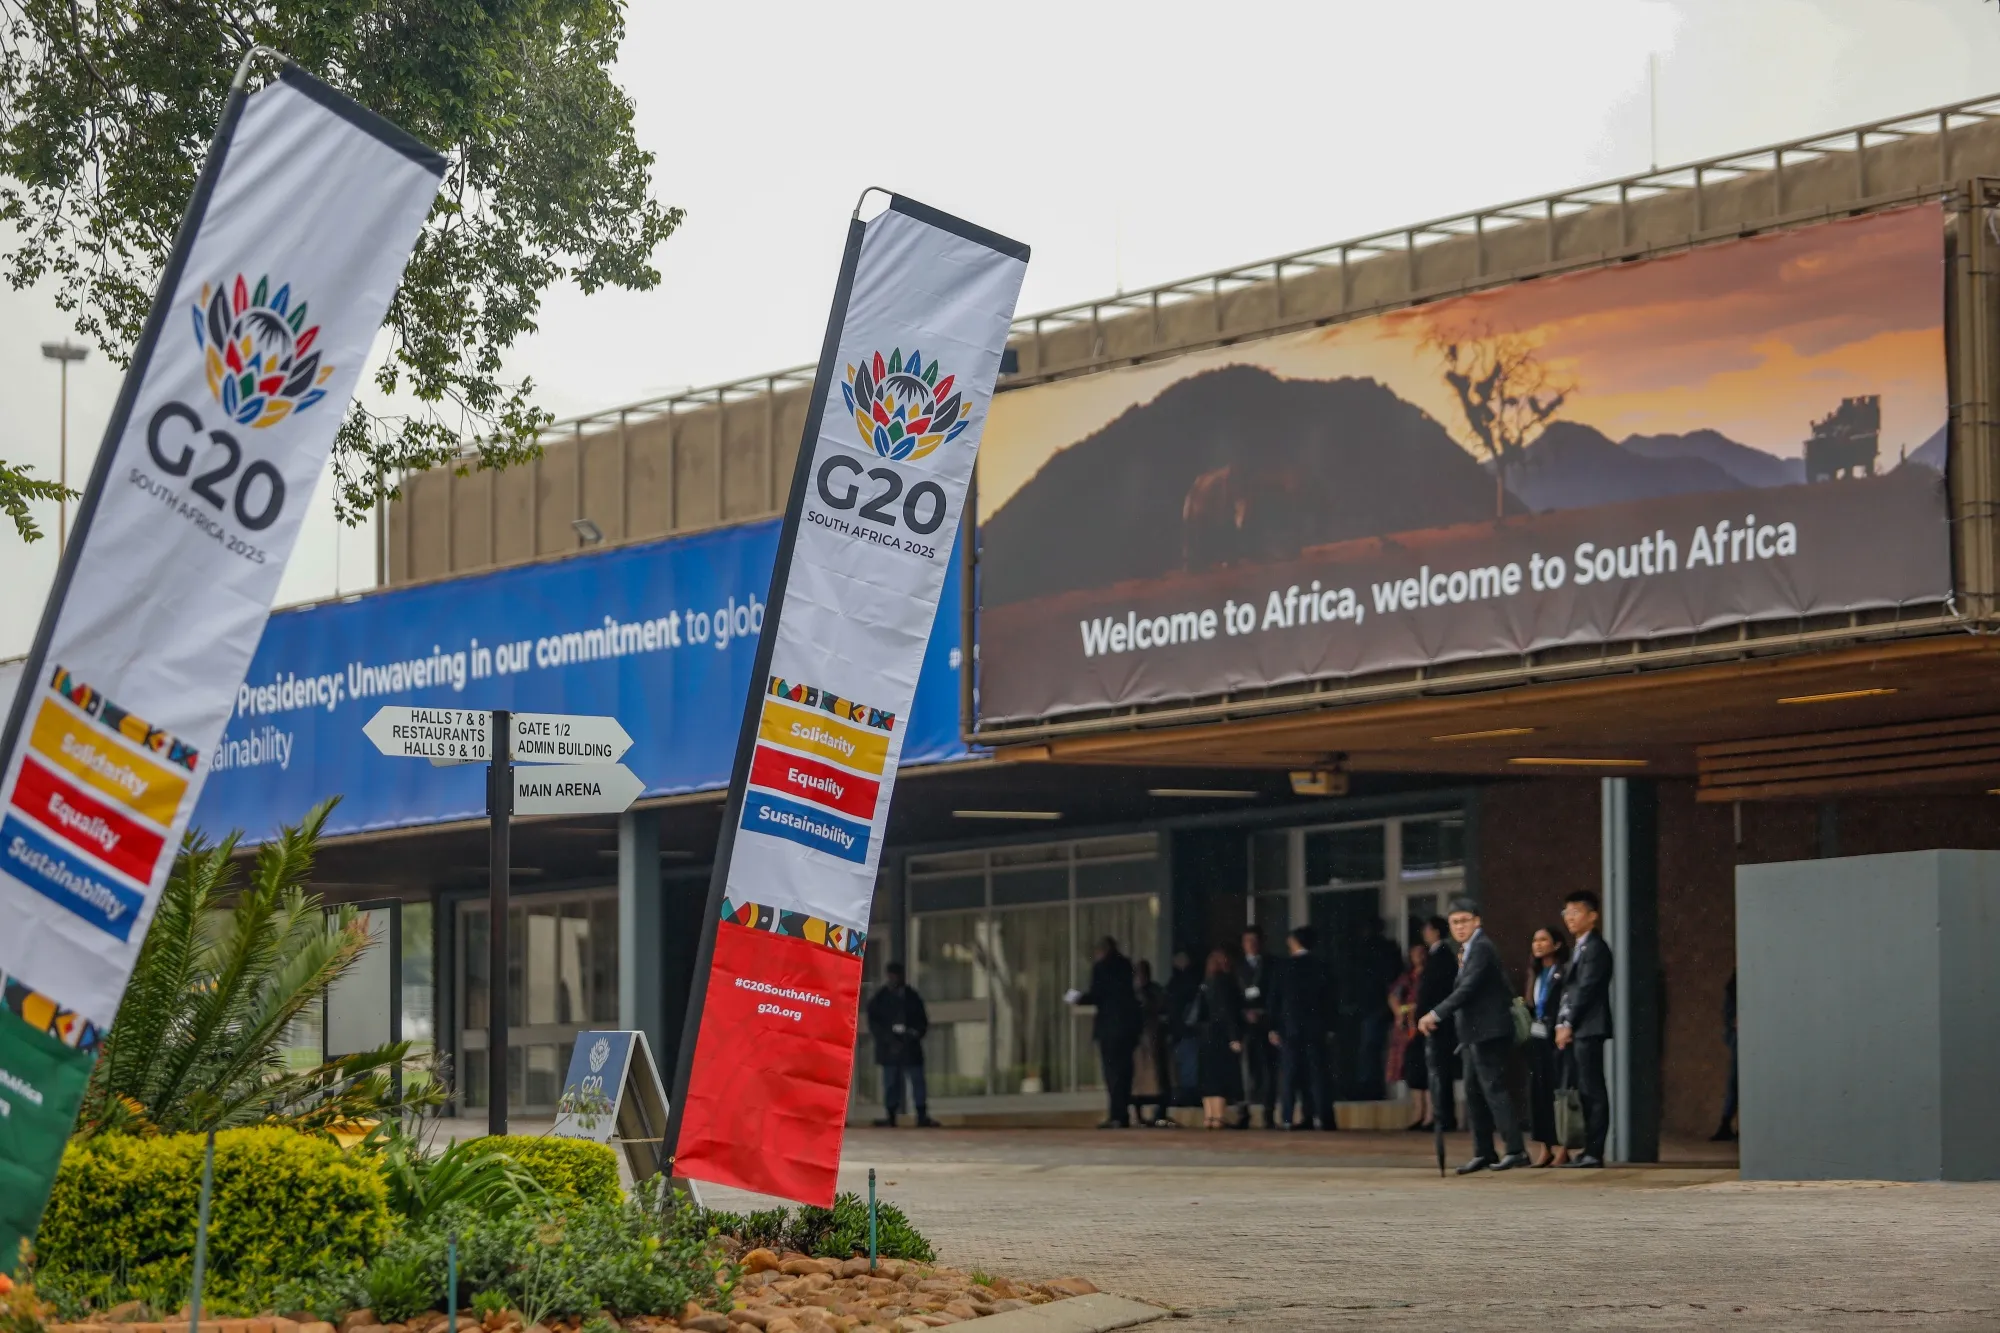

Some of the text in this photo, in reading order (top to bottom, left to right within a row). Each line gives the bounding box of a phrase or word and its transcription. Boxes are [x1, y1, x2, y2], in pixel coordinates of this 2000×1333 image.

[147, 401, 286, 531] G20
[817, 454, 947, 535] G20
[129, 468, 266, 564] SOUTH AFRICA 2025
[807, 511, 936, 559] SOUTH AFRICA 2025
[1079, 513, 1798, 658] Welcome to Africa, welcome to South Africa
[237, 592, 765, 718] Presidency: Unwavering in our commitment to glob
[393, 725, 485, 742] RESTAURANTS
[411, 709, 485, 726] HALLS 7 & 8
[518, 722, 571, 737] GATE 1/2
[209, 724, 294, 772] ainability
[404, 741, 485, 758] HALLS 9 & 10
[518, 740, 612, 757] ADMIN BUILDING
[790, 722, 856, 758] Solidarity
[61, 732, 149, 798] Solidarity
[788, 767, 844, 800] Equality
[519, 782, 602, 798] MAIN ARENA
[48, 792, 121, 852] Equality
[758, 805, 855, 849] Sustainability
[8, 836, 127, 922] Sustainability
[735, 977, 831, 1007] #G20SouthAfrica
[757, 1003, 802, 1021] g20.org
[581, 1075, 603, 1094] G20
